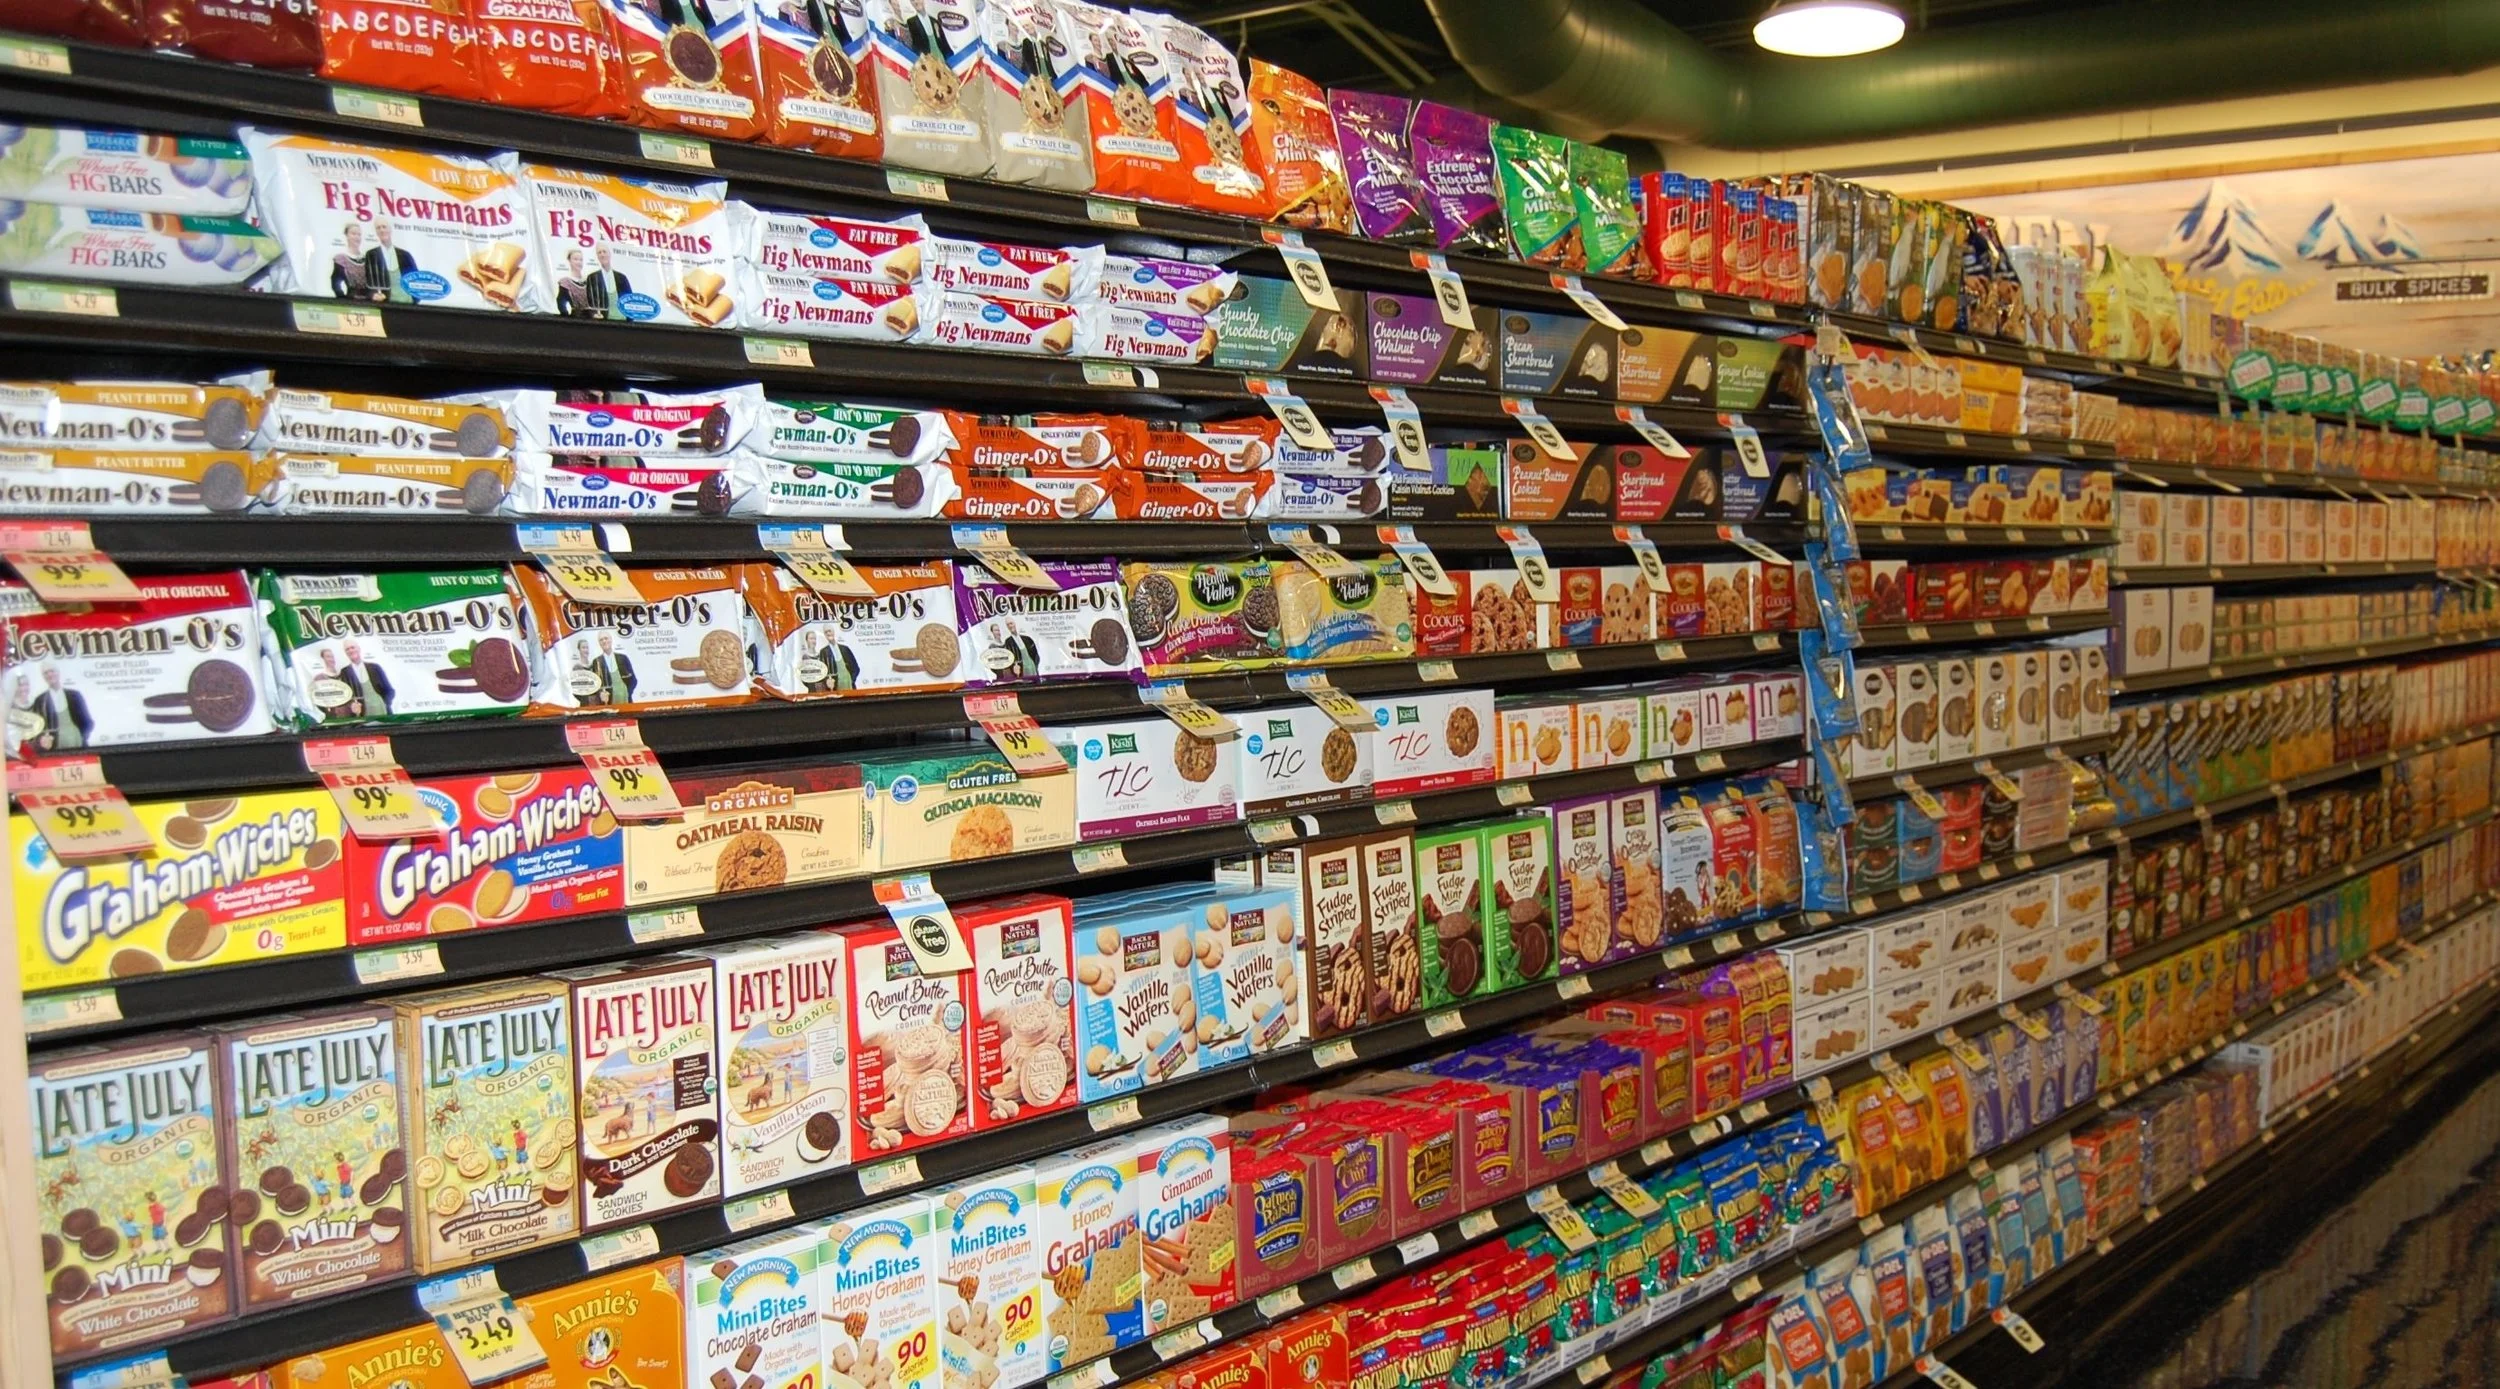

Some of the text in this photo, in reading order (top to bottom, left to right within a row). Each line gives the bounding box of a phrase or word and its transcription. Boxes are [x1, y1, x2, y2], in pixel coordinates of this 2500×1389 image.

[430, 168, 460, 184] LOW
[1427, 160, 1476, 173] Extreme
[69, 173, 162, 195] FIG BARS
[322, 181, 513, 227] Fig Newmans
[849, 228, 898, 246] FAT FREE
[71, 247, 167, 270] FIG BARS
[762, 246, 872, 274] Fig Newmans
[1009, 247, 1027, 261] FAT
[850, 281, 870, 294] FAT
[2350, 278, 2472, 297] BULK SPICES
[793, 300, 874, 325] Newmans
[1014, 301, 1055, 320] FAT FREE
[1219, 304, 1260, 324] Chunky
[1219, 321, 1269, 340] Chocolate
[1270, 327, 1296, 348] Chip
[1373, 321, 1442, 349] Chocolate Chip
[1505, 336, 1533, 353] Pecan
[1105, 334, 1188, 358] Fig Newmans
[1375, 340, 1414, 355] Walnut
[1505, 352, 1554, 369] Shortbread
[97, 393, 143, 404] PEANUT
[367, 401, 407, 415] PEANUT
[633, 409, 652, 421] OUR
[95, 456, 140, 468] PEANUT
[974, 447, 1057, 467] Ginger-O's
[1143, 450, 1220, 469] Ginger-O's
[1278, 446, 1335, 463] Newman-O's
[375, 463, 415, 475] PEANUT
[628, 471, 689, 484] OUR ORIGINAL
[1512, 467, 1543, 482] Peanut
[543, 487, 657, 510] Newman-O's
[1512, 481, 1541, 496] Cookies
[965, 498, 1050, 518] Ginger-O's
[1140, 501, 1214, 519] Ginger-O's
[431, 576, 458, 586] HINT
[473, 574, 498, 585] MINT
[143, 585, 229, 598] OUR ORIGINAL
[1203, 583, 1236, 601] Valley
[1339, 583, 1369, 600] Valley
[296, 600, 512, 639] Newman-O's
[1423, 614, 1464, 628] COOKIES
[994, 720, 1028, 733] SALE
[1111, 737, 1134, 749] Kashi
[1388, 730, 1432, 761] TLC
[598, 755, 643, 768] SALE
[340, 772, 394, 785] SALE
[949, 772, 1019, 789] GLUTEN FREE
[43, 792, 105, 806] SALE
[709, 792, 790, 811] ORGANIC
[923, 793, 1043, 822] QUINOA MACAROON
[675, 815, 824, 851] OATMEAL RAISIN
[1508, 861, 1536, 880] Fudge
[1371, 879, 1407, 907] Fudge
[1436, 873, 1466, 893] Fudge
[1317, 892, 1354, 916] Fudge
[1374, 895, 1411, 927] Striped
[1318, 906, 1358, 939] Striped
[923, 935, 945, 948] free
[1005, 928, 1036, 941] NATURE
[985, 956, 1059, 996] Peanut Butter
[729, 958, 837, 1031] LATE JULY
[1013, 979, 1044, 997] Creme
[865, 979, 949, 1019] Peanut Butter
[582, 981, 708, 1058] LATE JULY
[898, 1002, 933, 1022] Creme
[428, 1007, 561, 1089] LATE JULY
[239, 1046, 315, 1119] LATE
[304, 1033, 390, 1108] JULY
[36, 1064, 204, 1160] LATE JULY
[753, 1094, 826, 1138] Vanilla Bean
[608, 1122, 700, 1174] Dark Chocolate
[740, 1156, 784, 1175] SANDWICH
[745, 1168, 781, 1184] COOKIES
[1063, 1166, 1119, 1196] NEW MORNING
[1162, 1167, 1213, 1203] Cinnamon
[469, 1180, 532, 1215] Mini
[597, 1190, 648, 1213] SANDWICH
[956, 1189, 1014, 1218] NEW MORNING
[602, 1202, 643, 1221] COOKIES
[1072, 1202, 1114, 1230] Honey
[1342, 1199, 1378, 1218] Cookie
[289, 1215, 358, 1252] Mini
[458, 1214, 548, 1244] Milk Chocolate
[843, 1220, 906, 1252] NEW MORNING
[272, 1251, 381, 1286] White Chocolate
[947, 1240, 1032, 1278] Honey Graham
[97, 1258, 173, 1299] Mini
[726, 1259, 792, 1293] NEW MORNING
[832, 1272, 925, 1313] Honey Graham
[76, 1296, 200, 1336] White Chocolate
[552, 1288, 640, 1339] Annie's
[1004, 1294, 1034, 1329] 90
[708, 1310, 817, 1358] Chocolate Graham
[897, 1331, 928, 1369] 90
